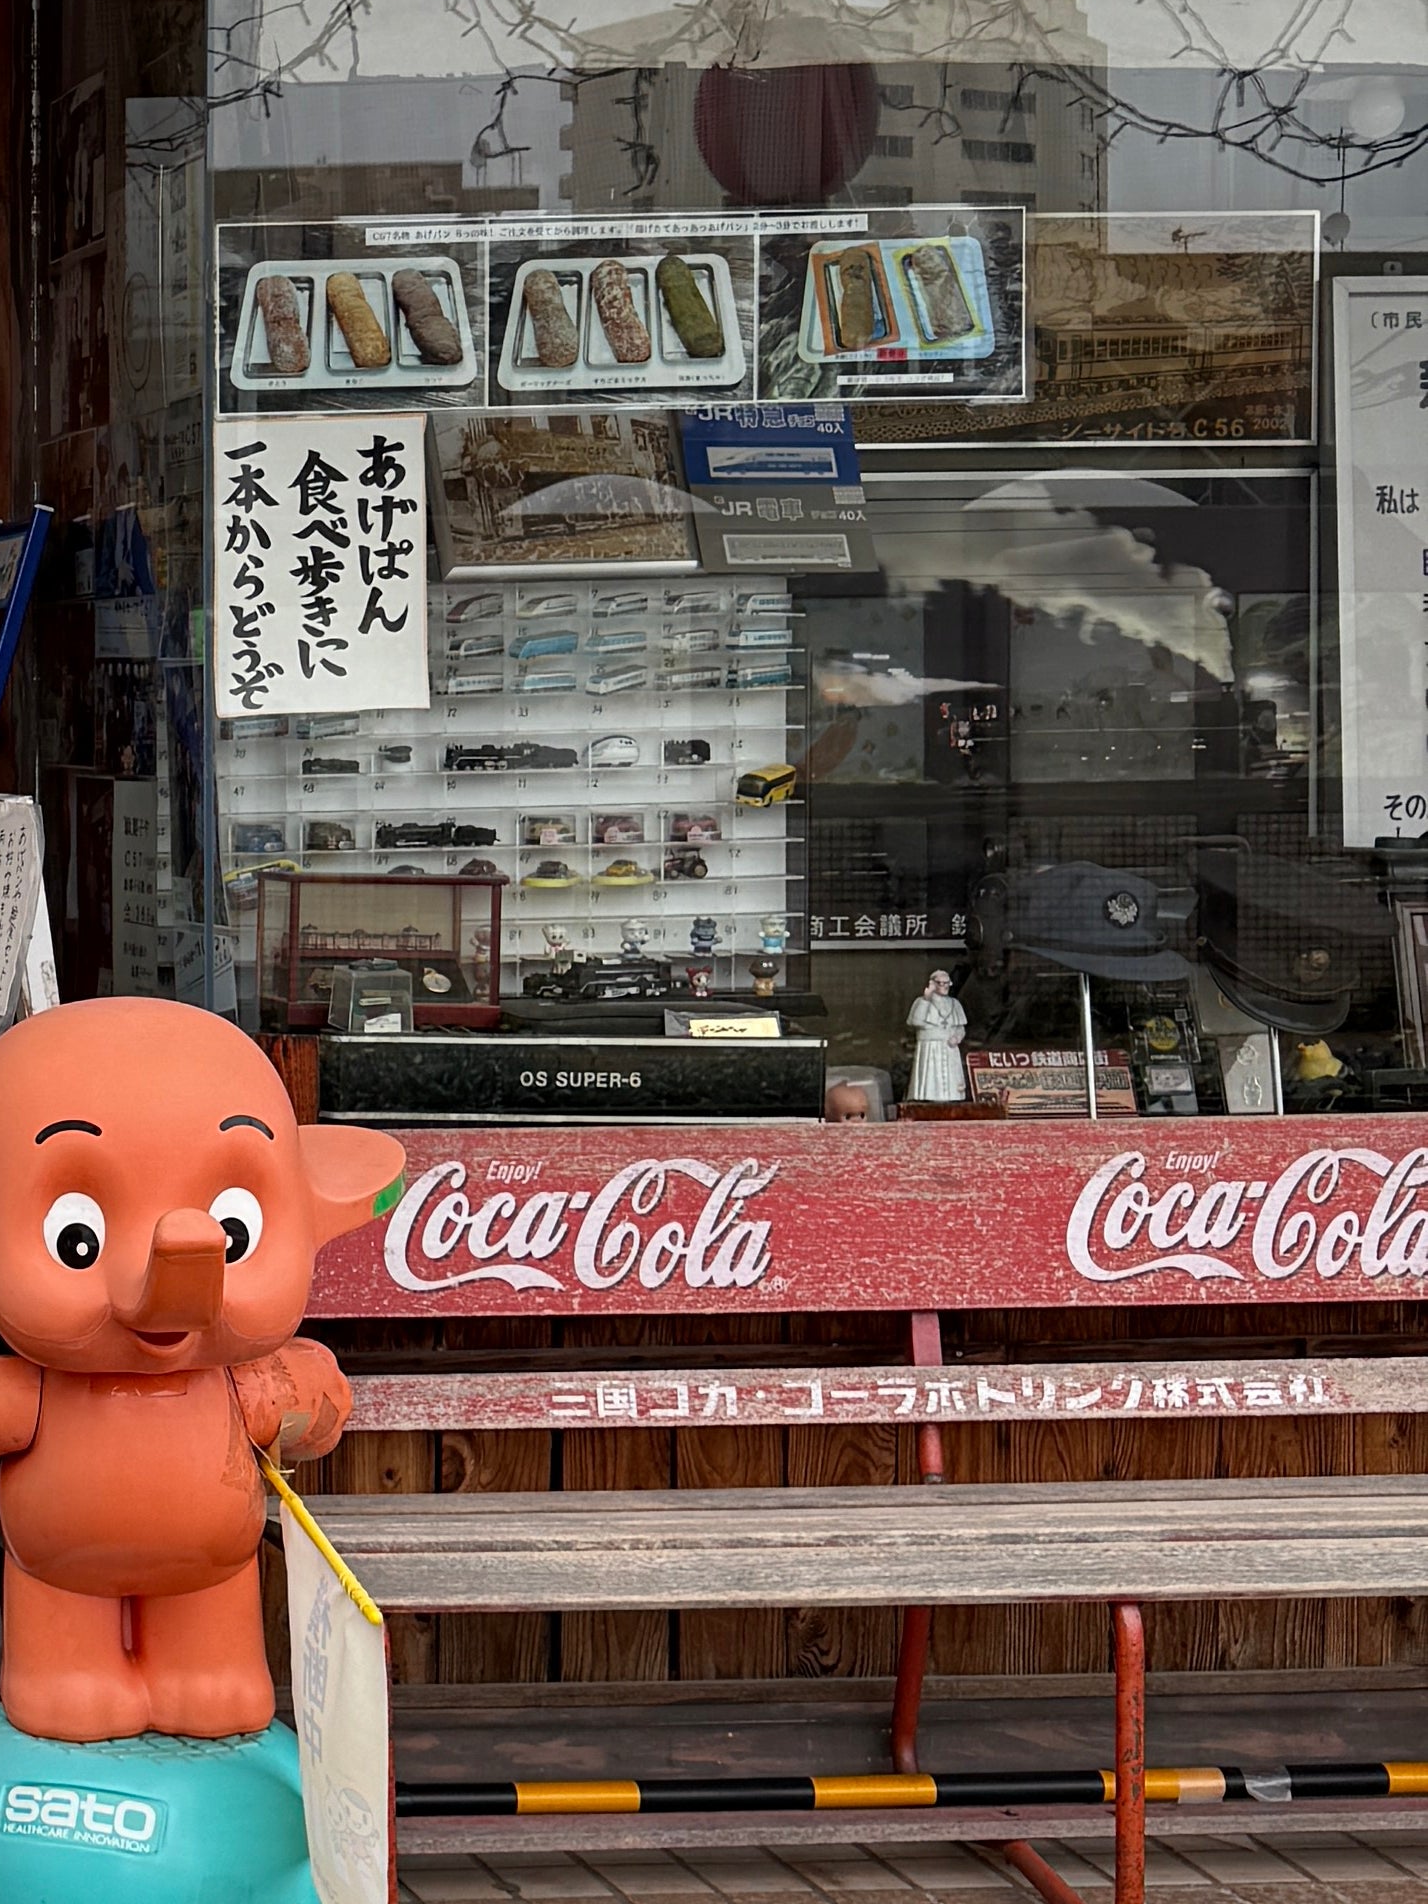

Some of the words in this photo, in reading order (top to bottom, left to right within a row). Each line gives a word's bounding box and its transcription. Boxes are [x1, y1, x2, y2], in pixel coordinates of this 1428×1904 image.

[721, 500, 754, 517] JR
[756, 497, 805, 522] 電車
[1375, 484, 1421, 515] 私は
[356, 434, 418, 636] あげぱん
[223, 440, 285, 710] 一本からどうぞ
[288, 449, 350, 679] 食べ歩きに
[519, 1070, 548, 1088] OS
[555, 1070, 642, 1089] SUPER-6
[485, 1158, 543, 1183] Enjoy!
[1164, 1151, 1221, 1173] Enjoy!
[383, 1155, 782, 1293] Coca-Cola
[4, 1784, 157, 1841] sato
[3, 1822, 70, 1841] HEALTHCARE
[72, 1829, 151, 1854] INNOVATION
